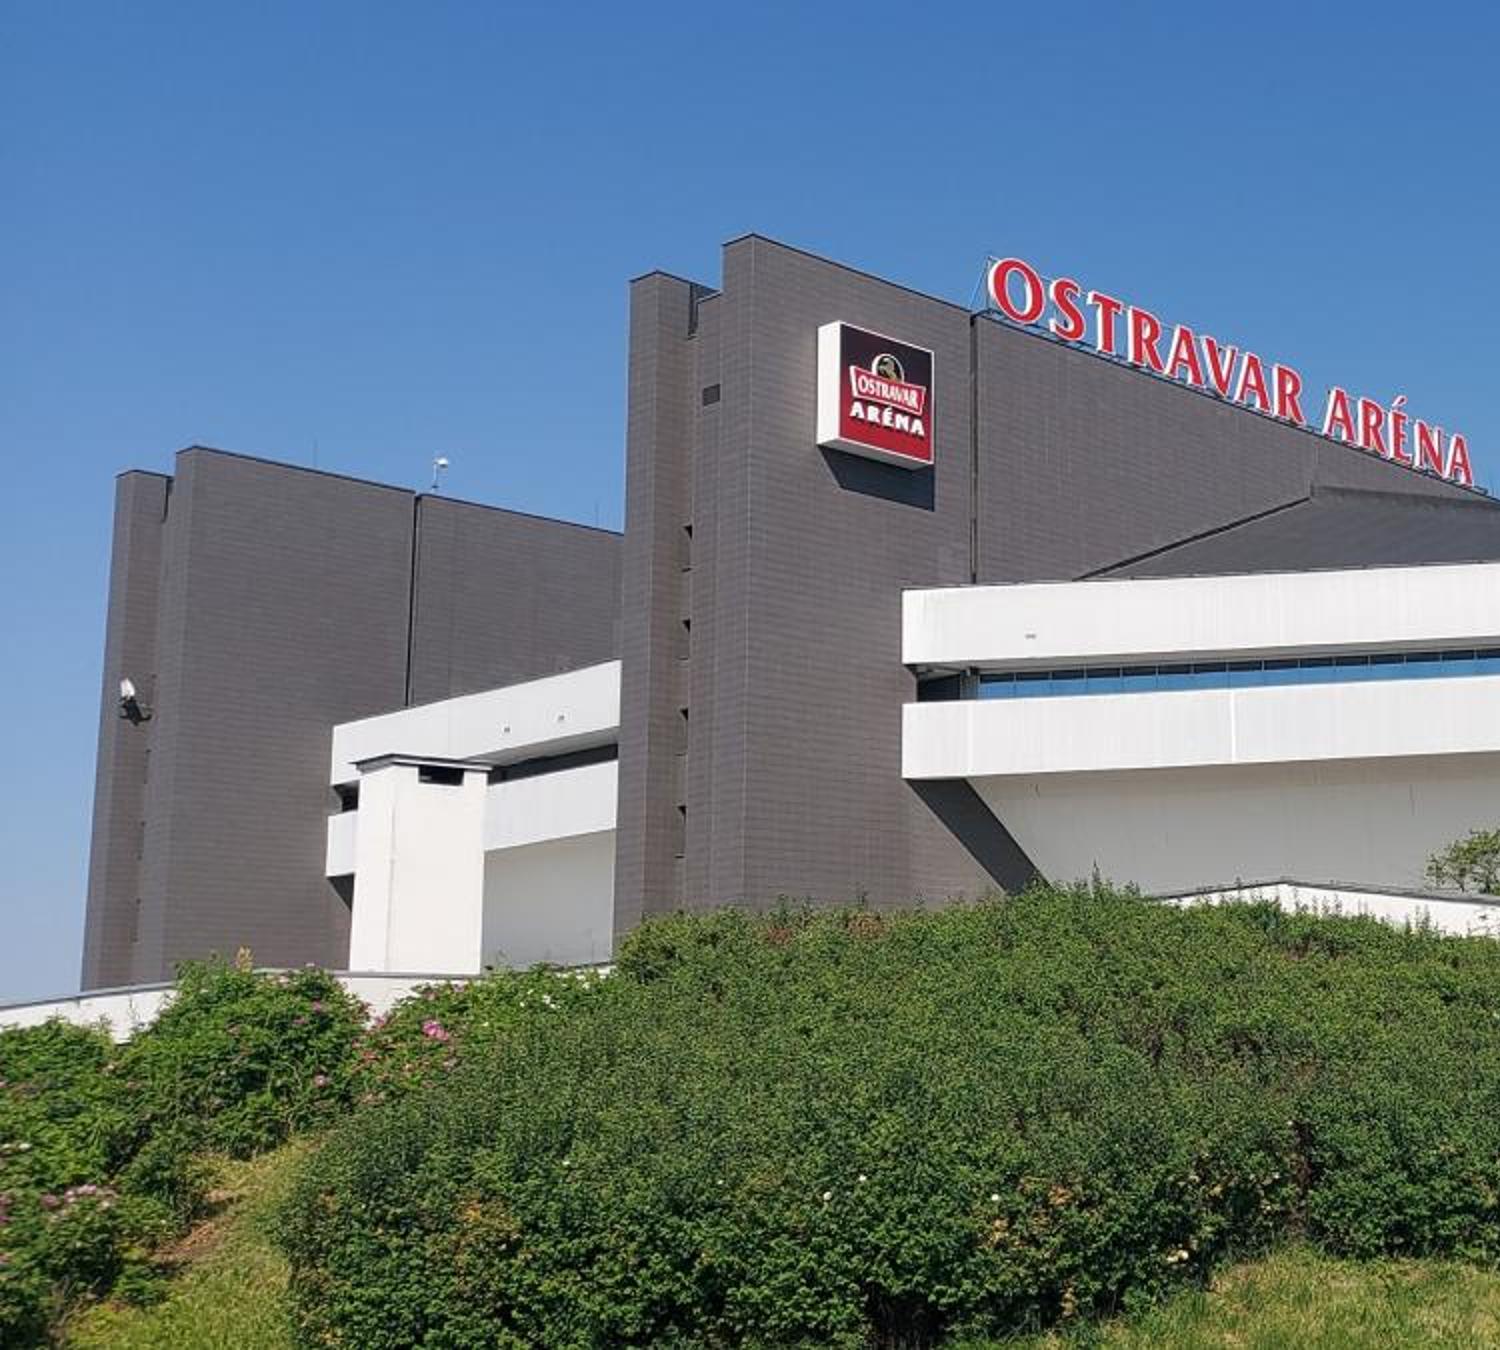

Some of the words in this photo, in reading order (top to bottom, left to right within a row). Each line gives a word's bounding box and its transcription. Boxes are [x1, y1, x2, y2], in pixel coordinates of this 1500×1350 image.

[987, 257, 1306, 425] OSTRAVAR
[1322, 386, 1474, 487] ARÉNA
[858, 374, 919, 410] OSTRAVAR
[850, 401, 925, 436] ARÉNA
